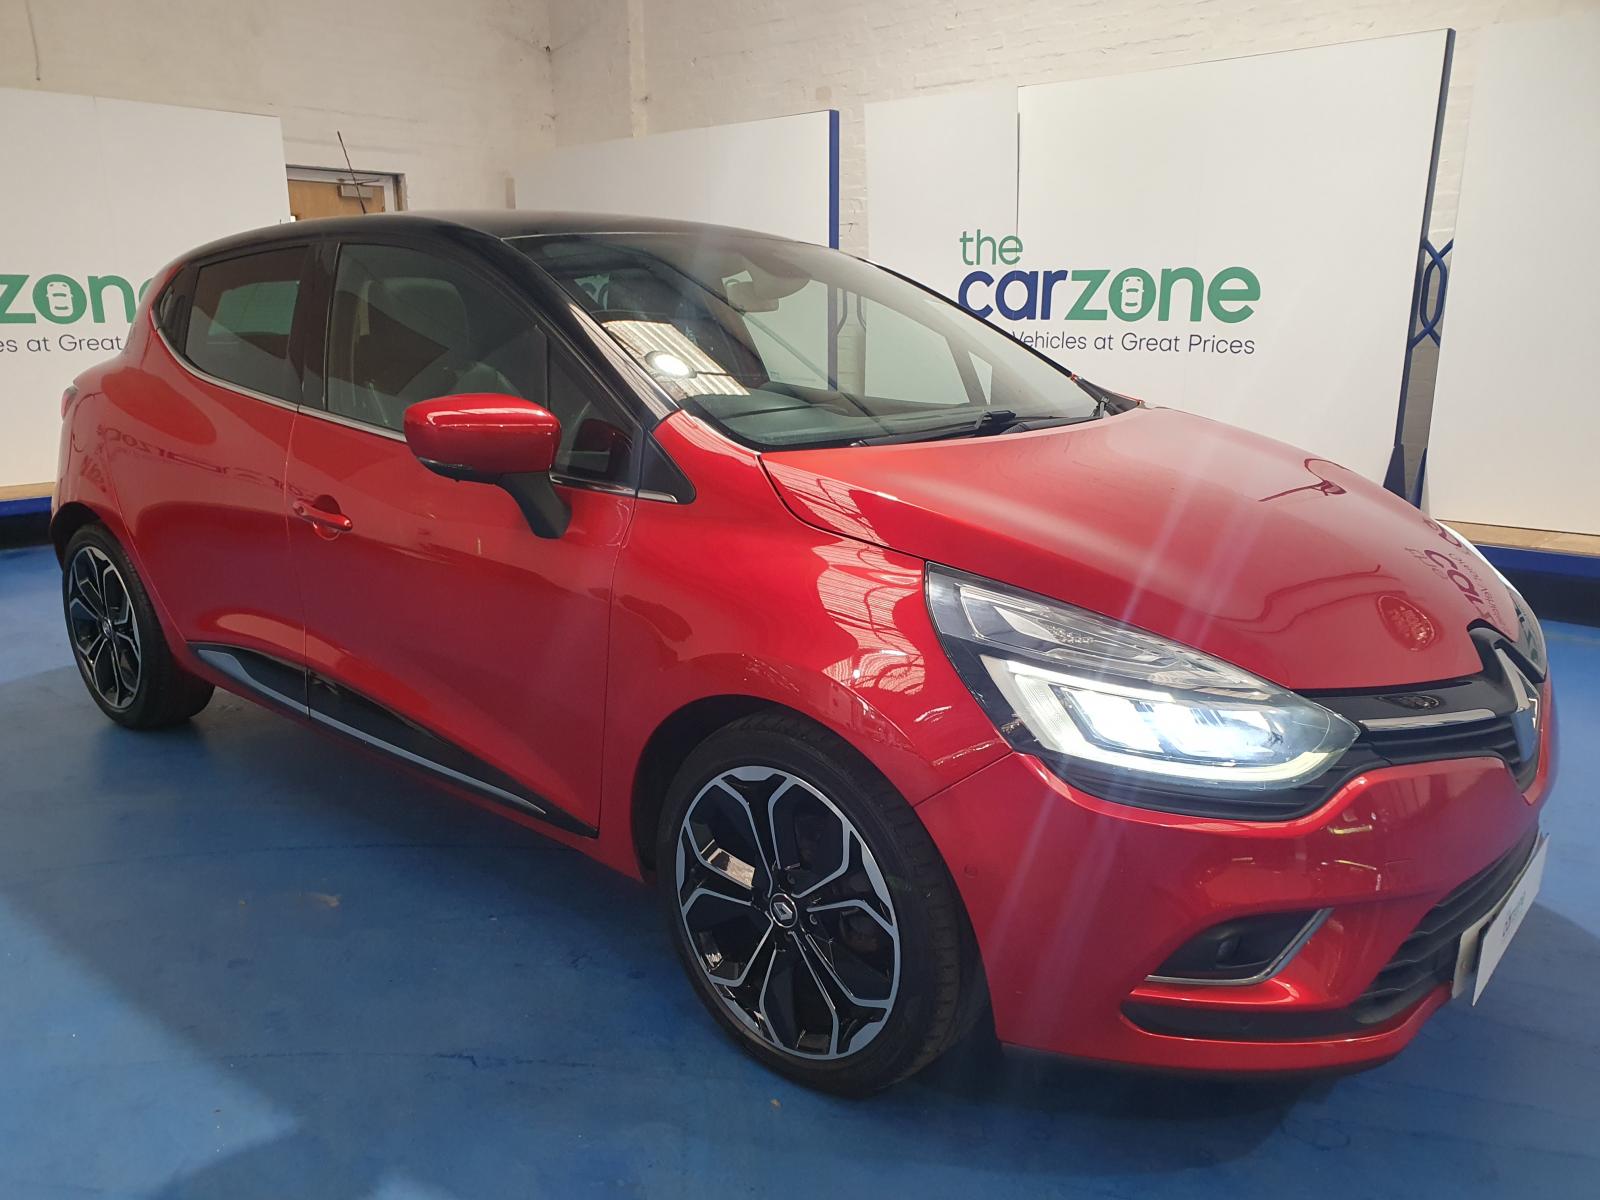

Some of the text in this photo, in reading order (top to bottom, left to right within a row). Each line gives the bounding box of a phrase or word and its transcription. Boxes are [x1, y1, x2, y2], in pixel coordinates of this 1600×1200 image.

[959, 229, 1023, 265] the
[0, 273, 152, 324] zon
[958, 266, 1261, 323] carzone
[26, 336, 51, 352] at
[58, 334, 123, 352] Great
[1094, 333, 1114, 350] at
[1121, 332, 1180, 352] Great
[1188, 334, 1255, 354] Prices
